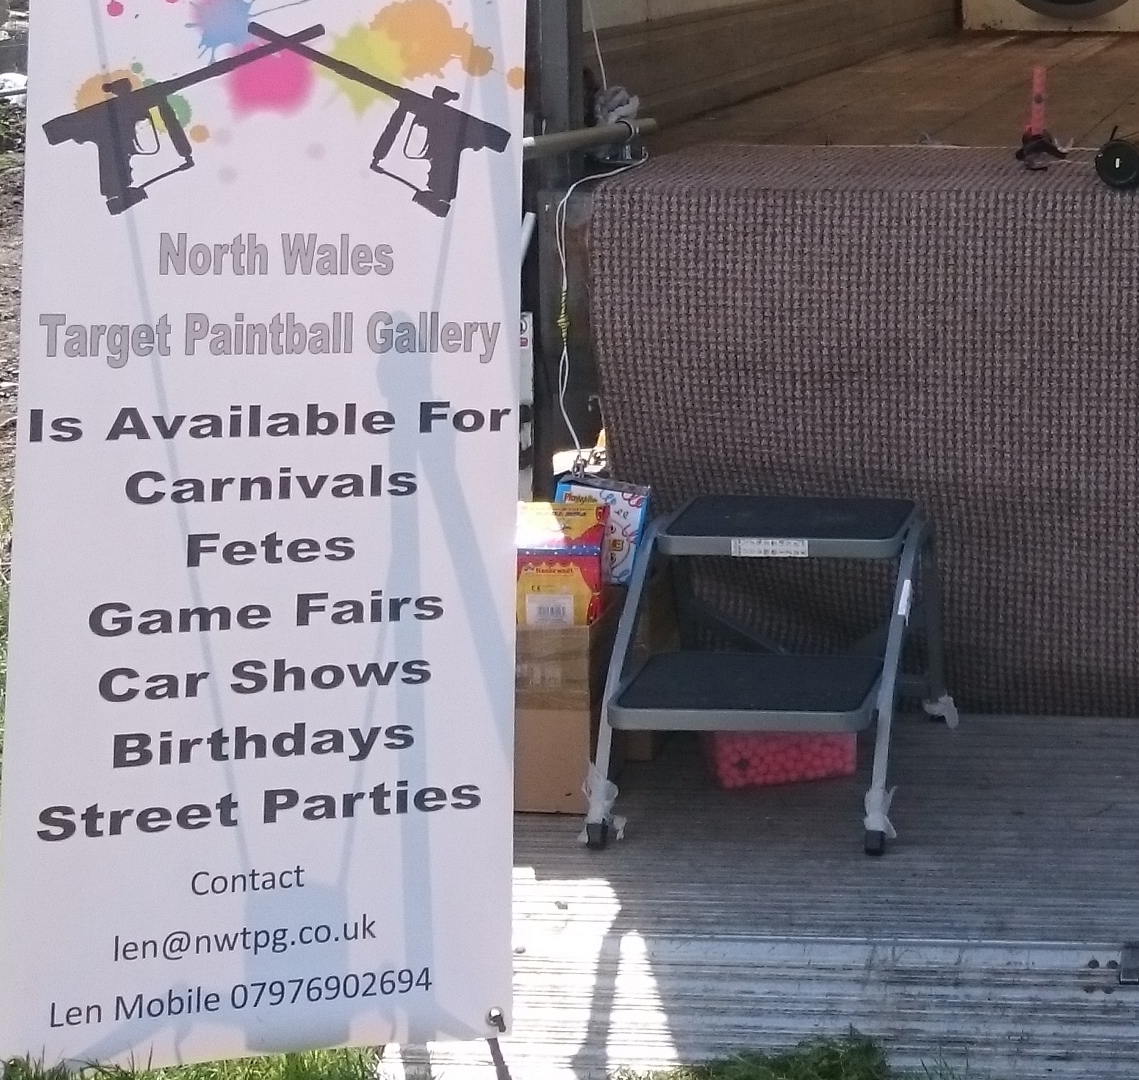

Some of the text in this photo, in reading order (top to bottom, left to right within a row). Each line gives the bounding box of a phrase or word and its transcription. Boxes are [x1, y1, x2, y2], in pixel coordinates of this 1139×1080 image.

[158, 232, 395, 276] North Wales
[39, 310, 501, 369] Target Paintball Gallery
[29, 401, 512, 443] Is Available For
[125, 464, 418, 505] Carnivals
[186, 531, 356, 568] Fetes
[88, 589, 444, 638] Game Fairs
[98, 658, 432, 703] Car Shows
[112, 722, 415, 769] Birthdays
[36, 779, 482, 842] Street Parties
[191, 865, 305, 896] Contact
[113, 913, 376, 962] len@nwtpg.co.uk
[50, 966, 433, 1028] Len Mobile 07976902694
